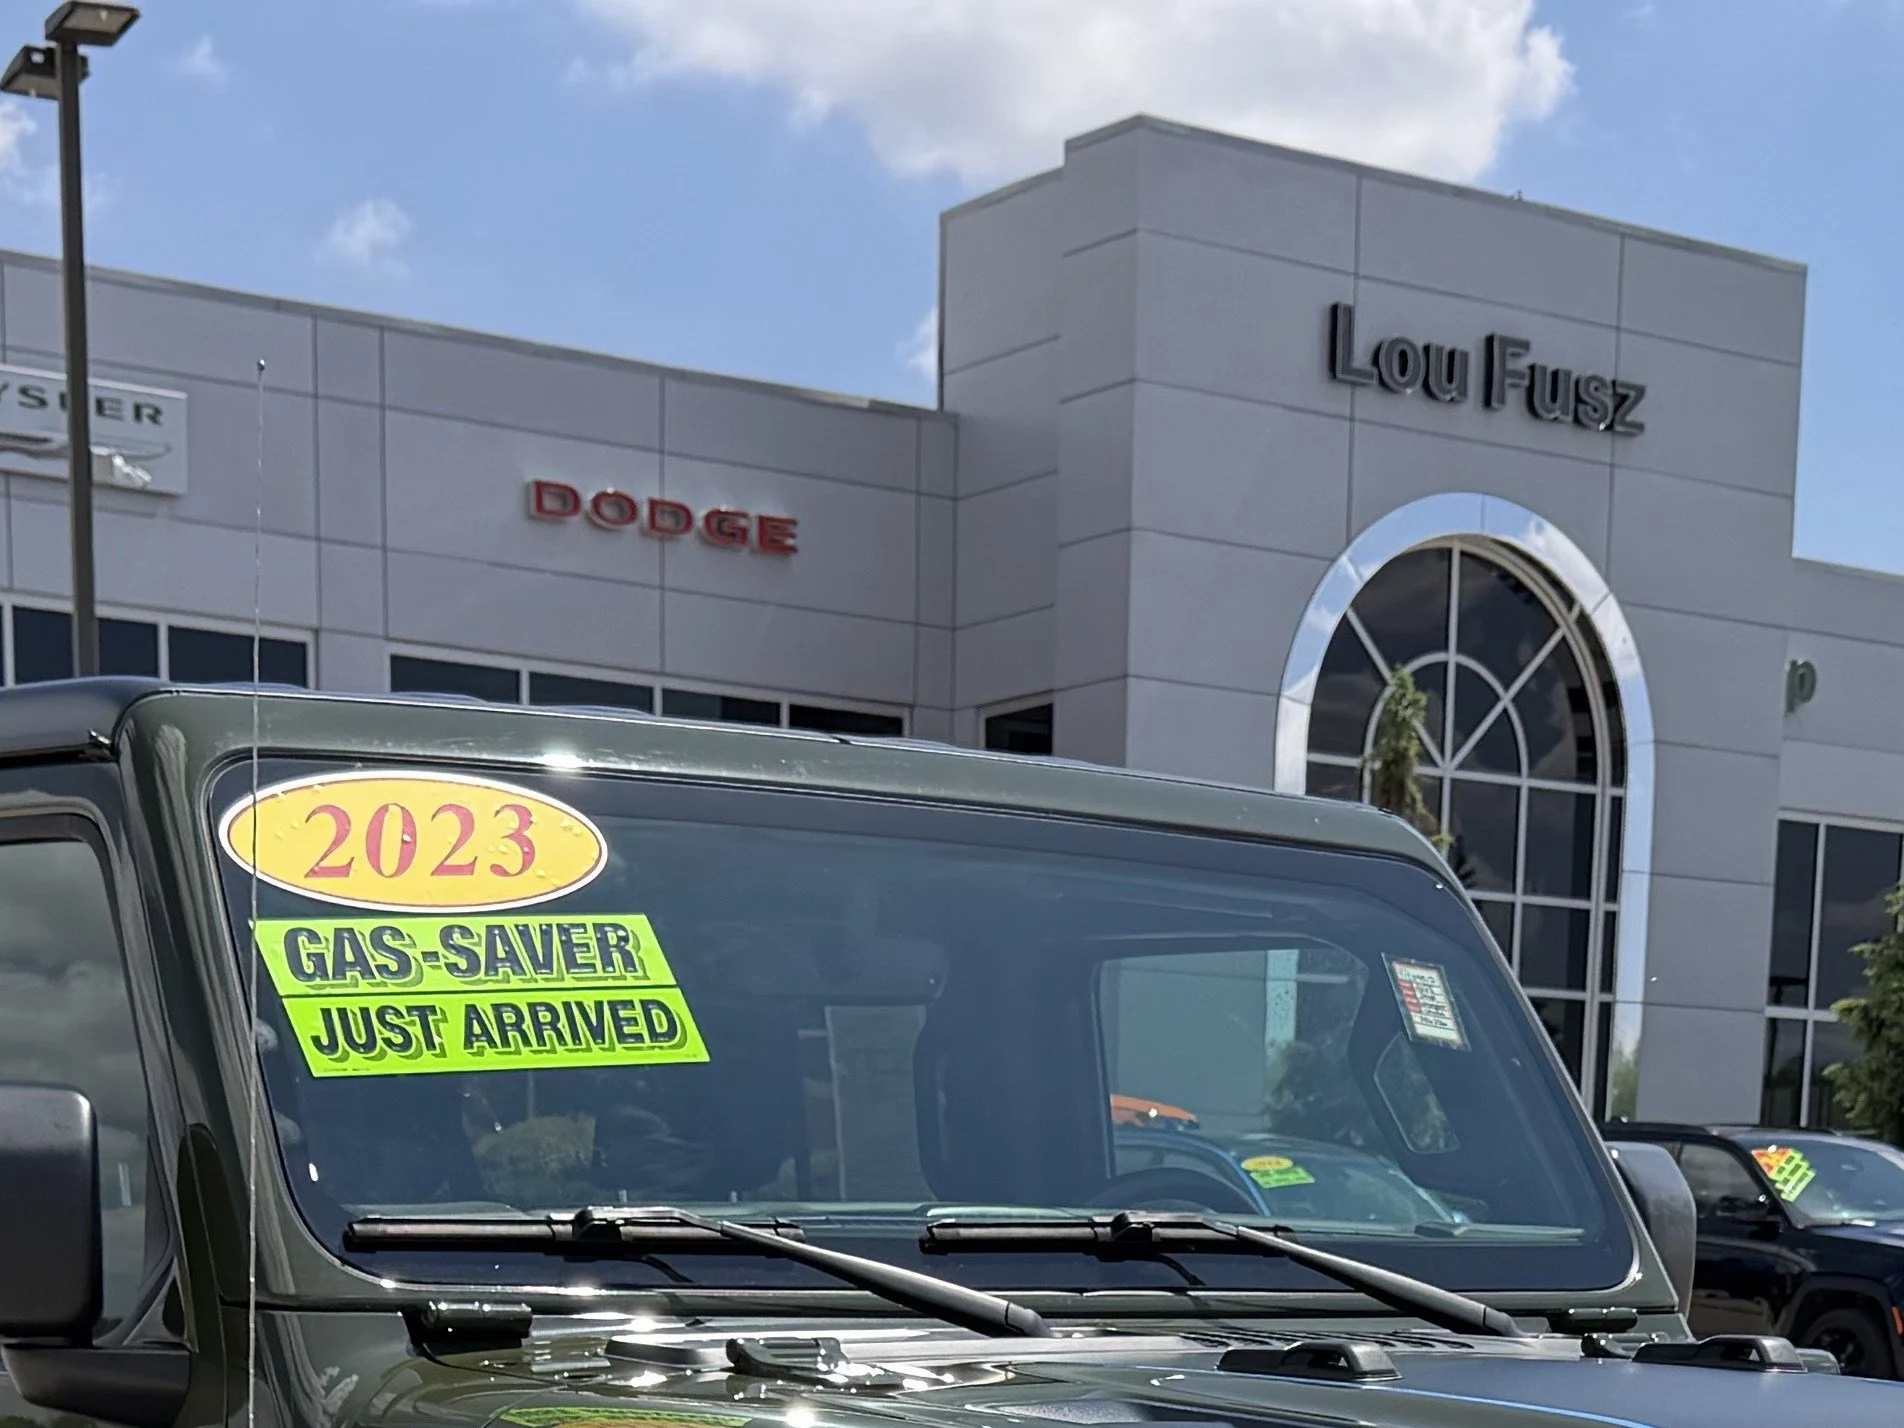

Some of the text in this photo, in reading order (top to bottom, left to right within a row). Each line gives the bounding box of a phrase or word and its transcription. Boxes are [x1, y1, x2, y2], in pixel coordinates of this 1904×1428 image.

[1328, 301, 1646, 436] Lou Fusz
[530, 480, 799, 555] DODGE
[304, 803, 536, 879] 2023
[283, 922, 647, 987] GAS-SAVER
[311, 999, 687, 1061] JUST ARRIVED
